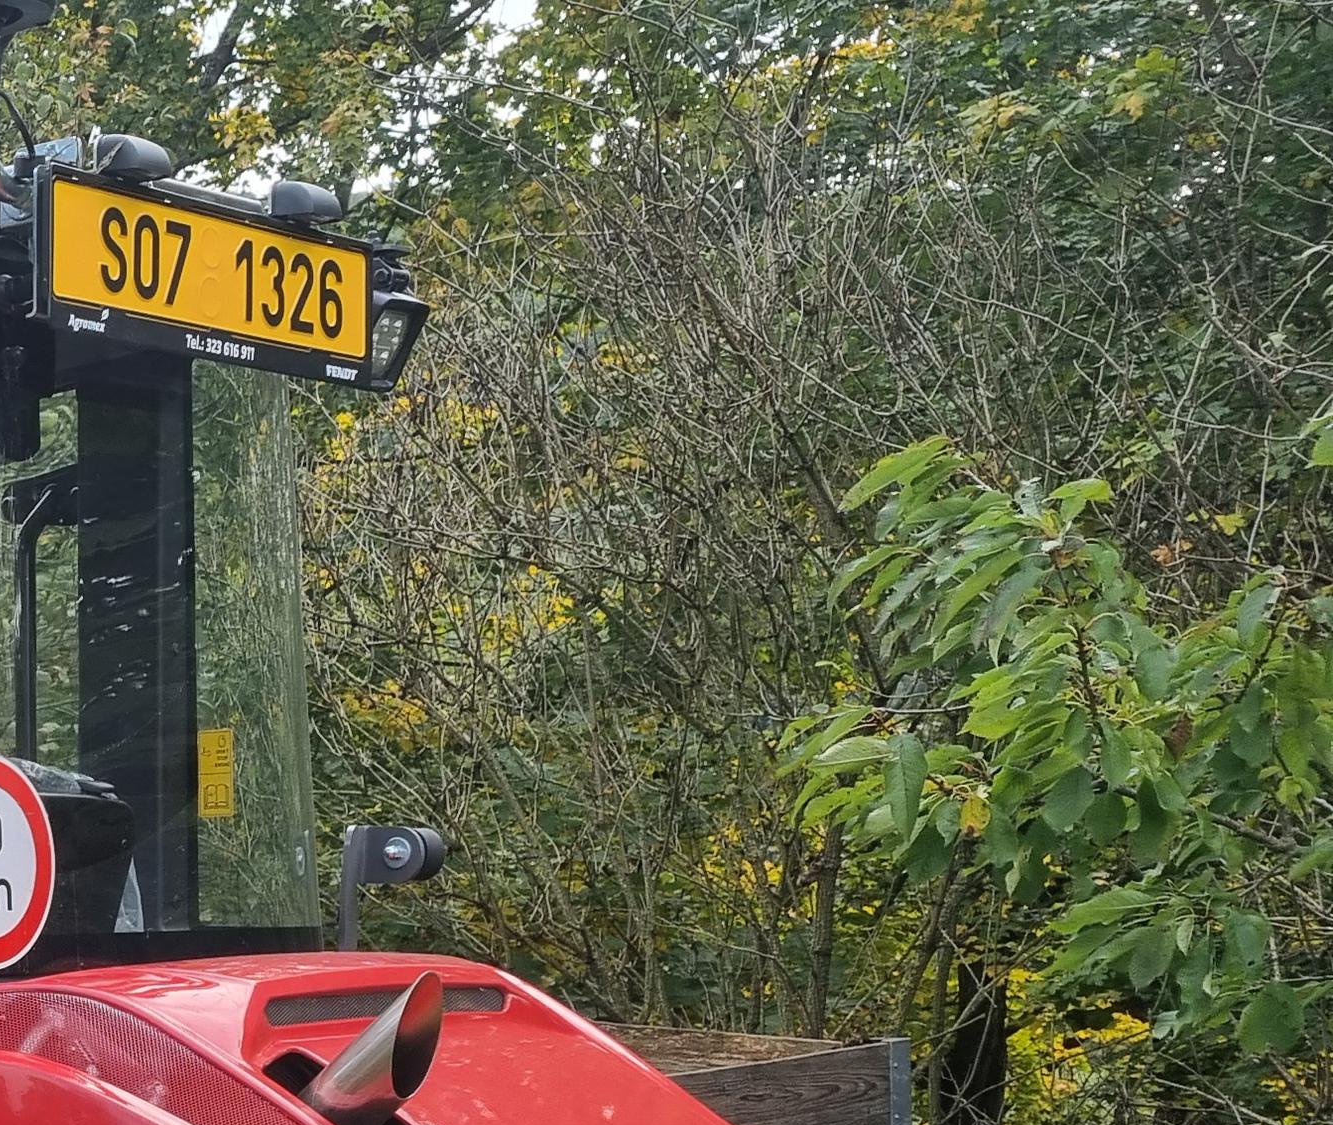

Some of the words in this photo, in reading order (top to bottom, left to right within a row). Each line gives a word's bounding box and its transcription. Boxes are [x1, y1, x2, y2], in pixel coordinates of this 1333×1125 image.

[100, 206, 192, 306] S07
[235, 238, 343, 339] 1326
[185, 333, 205, 351] Tel.:
[205, 337, 223, 355] 323
[223, 341, 240, 358] 616
[240, 345, 256, 361] 911
